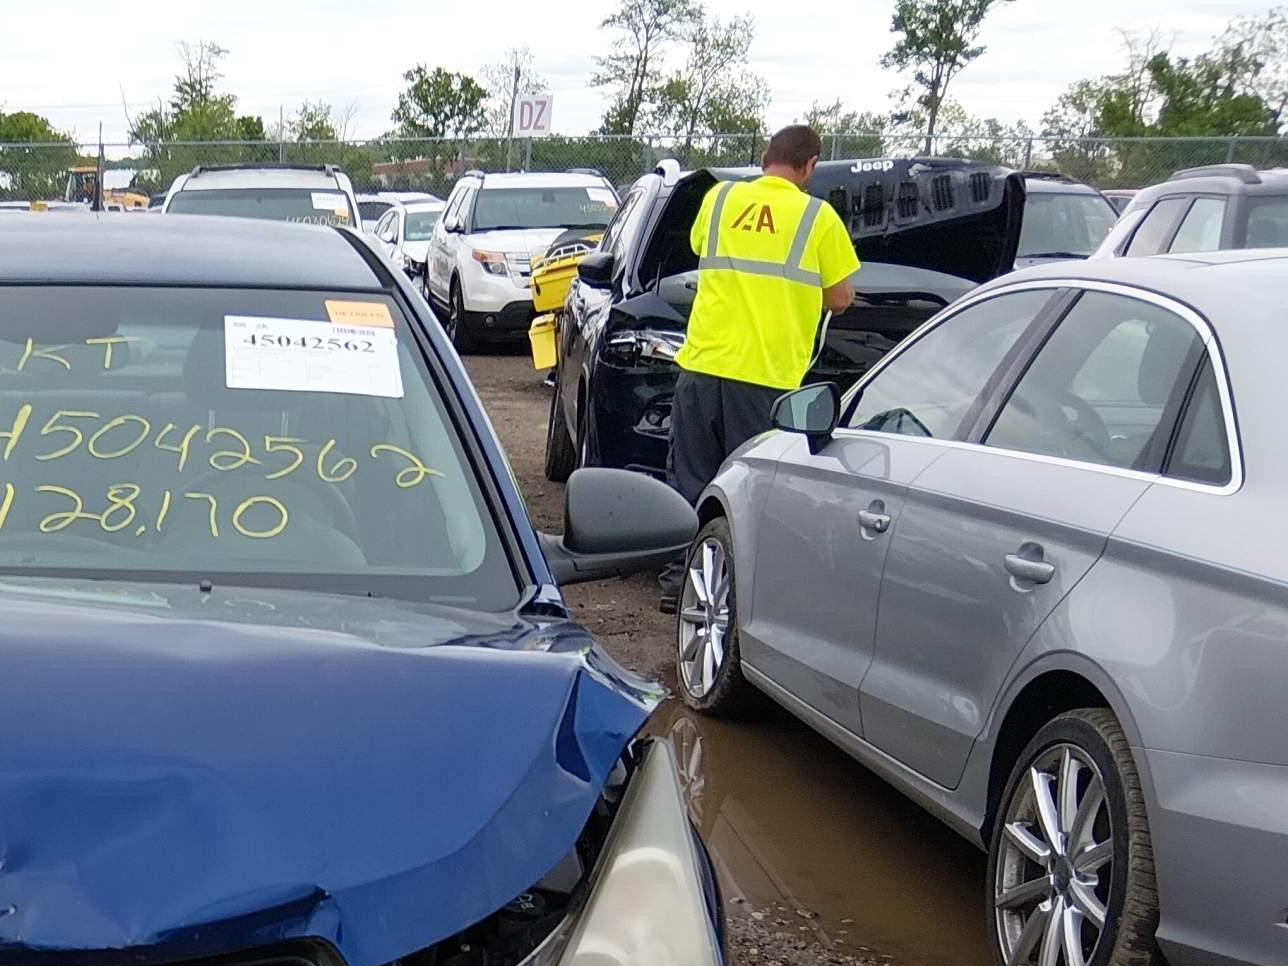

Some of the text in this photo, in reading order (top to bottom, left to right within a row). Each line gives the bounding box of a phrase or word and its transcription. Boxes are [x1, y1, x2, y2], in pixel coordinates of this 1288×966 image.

[519, 100, 547, 130] DZ
[850, 159, 894, 173] Jeep
[242, 333, 376, 353] 45042562
